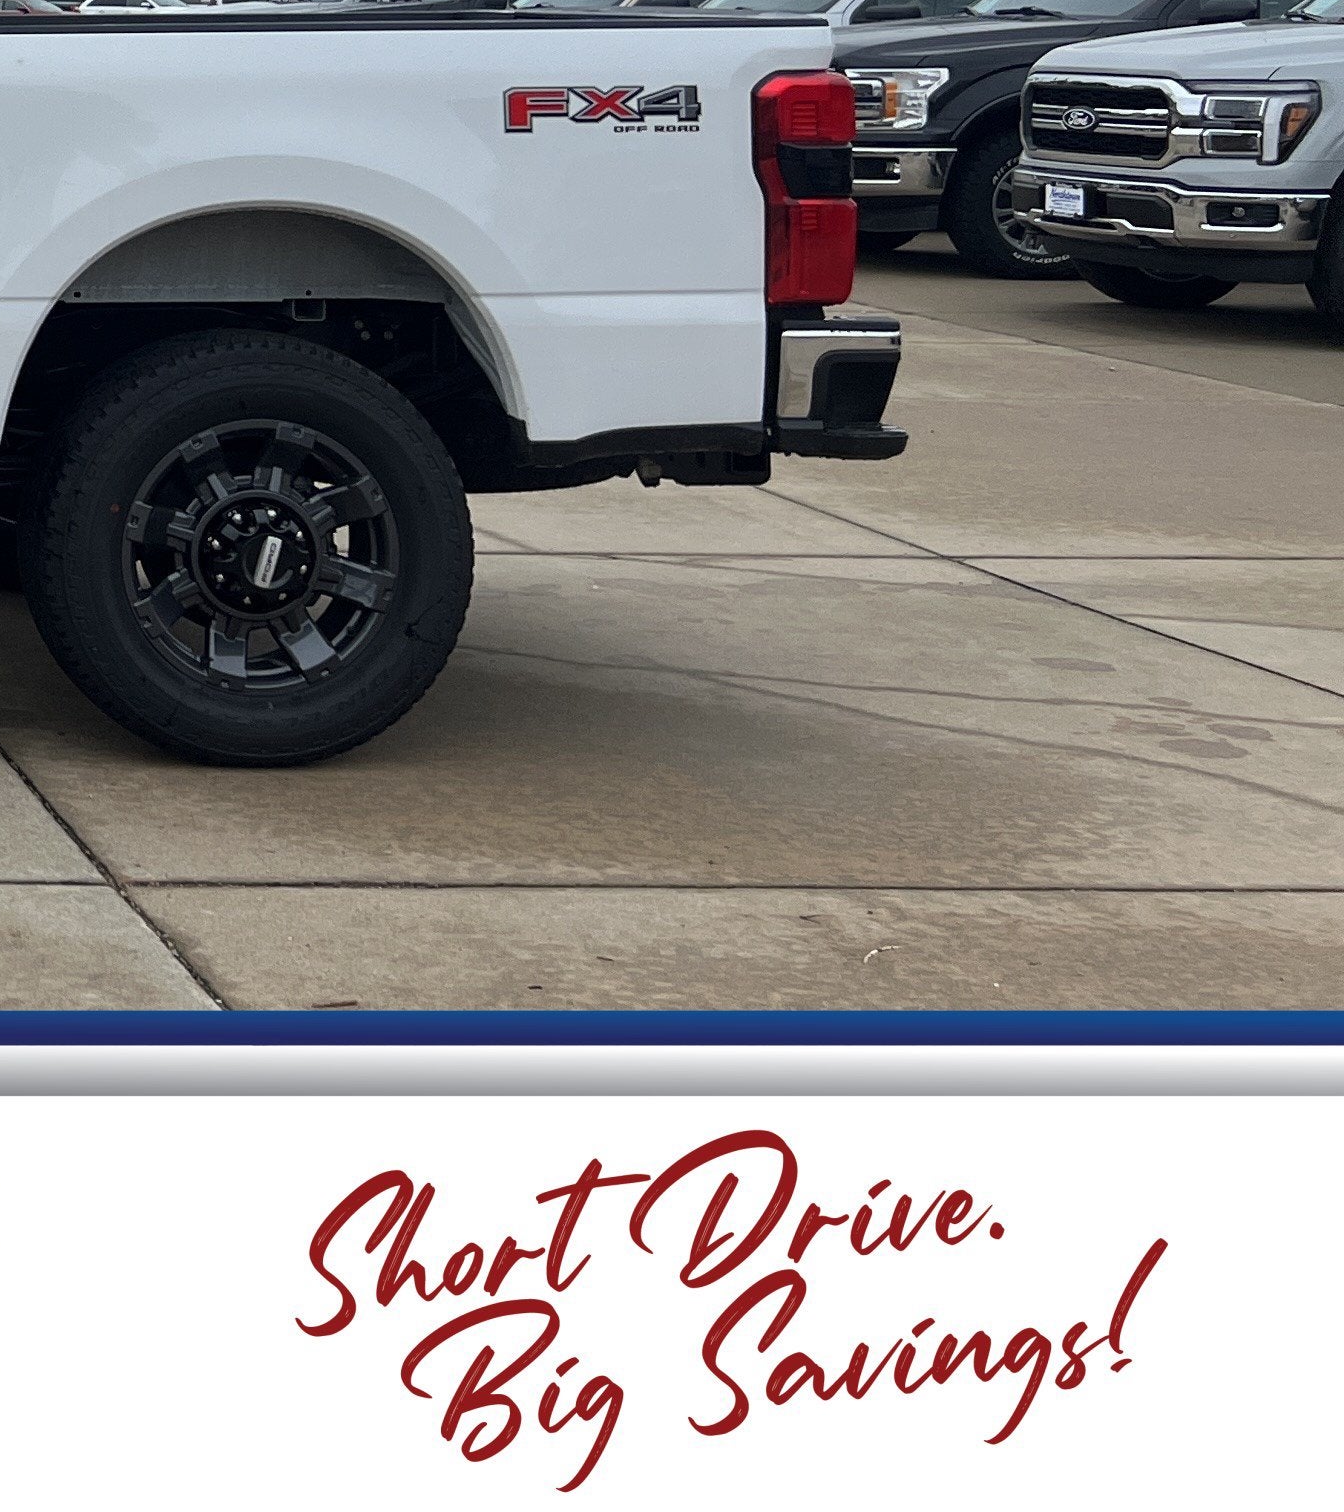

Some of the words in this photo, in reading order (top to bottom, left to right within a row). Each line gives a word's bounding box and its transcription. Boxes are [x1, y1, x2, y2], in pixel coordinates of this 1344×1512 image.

[503, 86, 700, 133] FX4
[613, 125, 648, 133] OFF
[654, 124, 700, 133] ROAD
